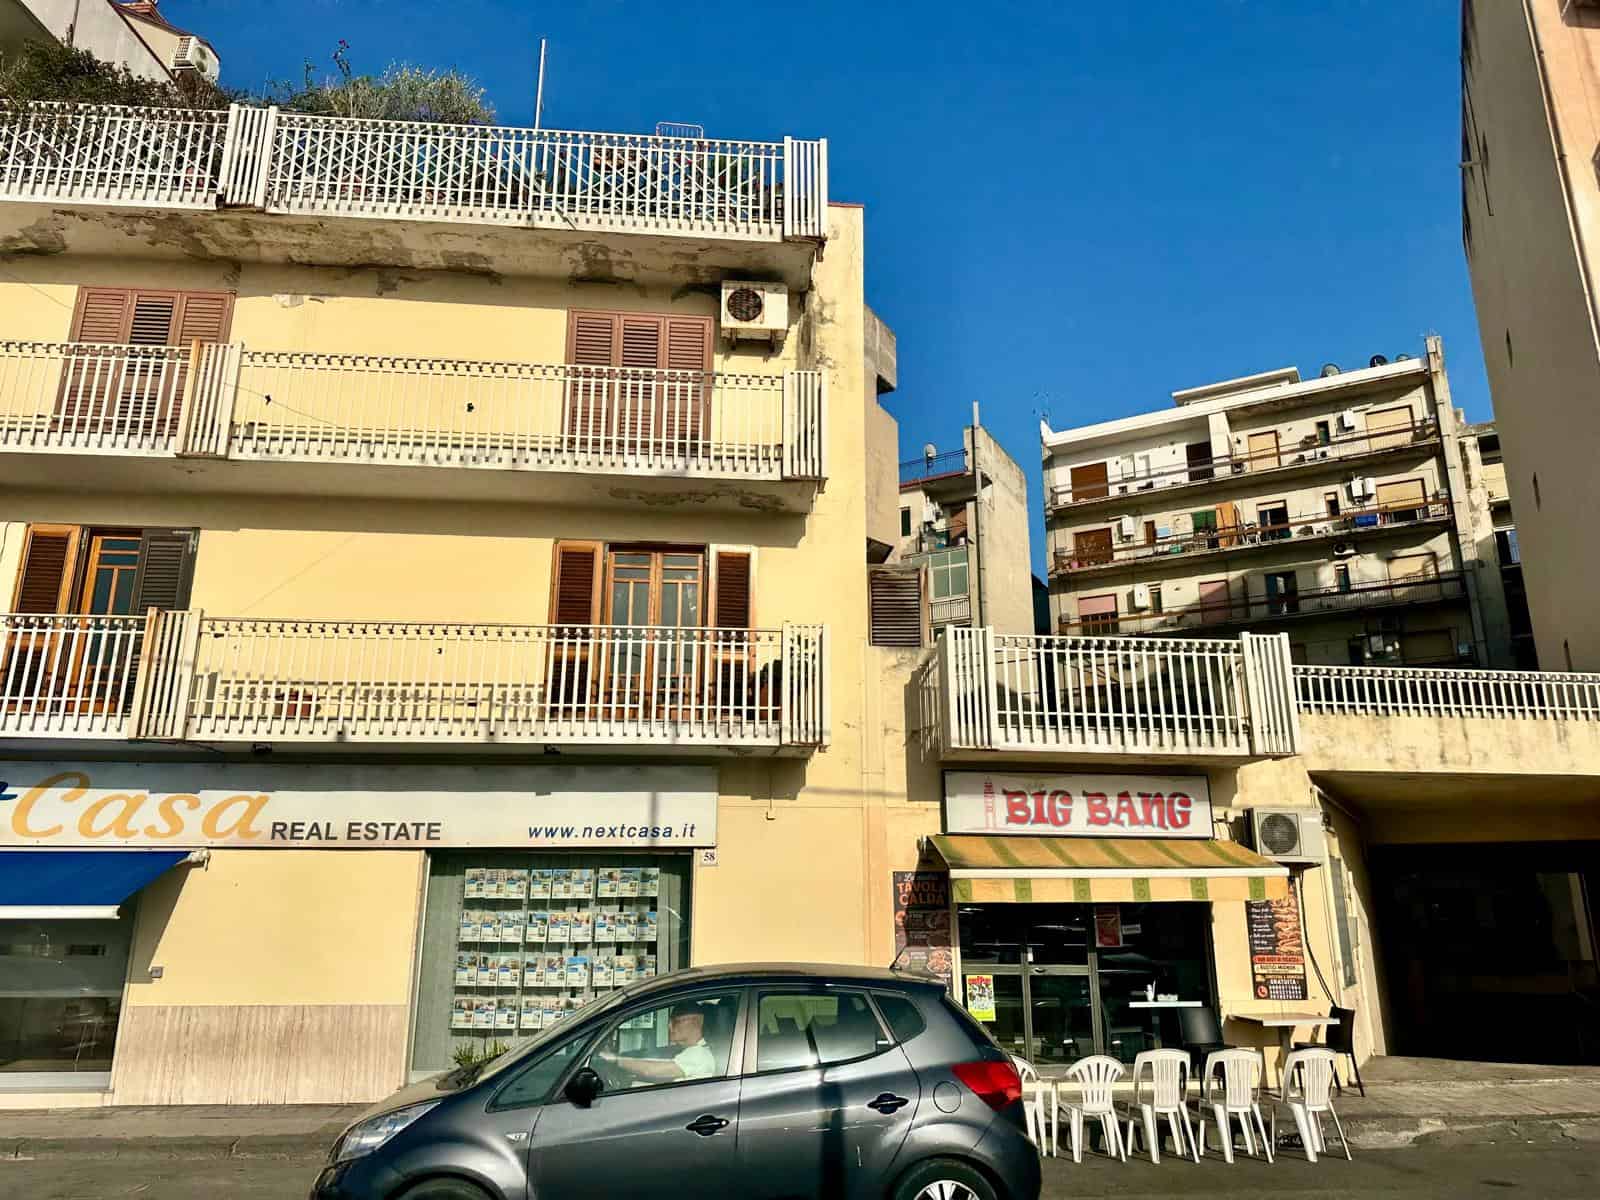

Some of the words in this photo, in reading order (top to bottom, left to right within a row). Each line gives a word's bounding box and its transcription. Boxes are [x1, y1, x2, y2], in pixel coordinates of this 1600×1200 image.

[11, 771, 270, 839] Casa
[1002, 788, 1074, 827] BIG
[1081, 789, 1192, 831] BANG
[270, 821, 338, 841] REAL
[346, 821, 442, 841] ESTATE
[528, 823, 696, 839] www.nextcasa.it
[703, 851, 715, 862] 58
